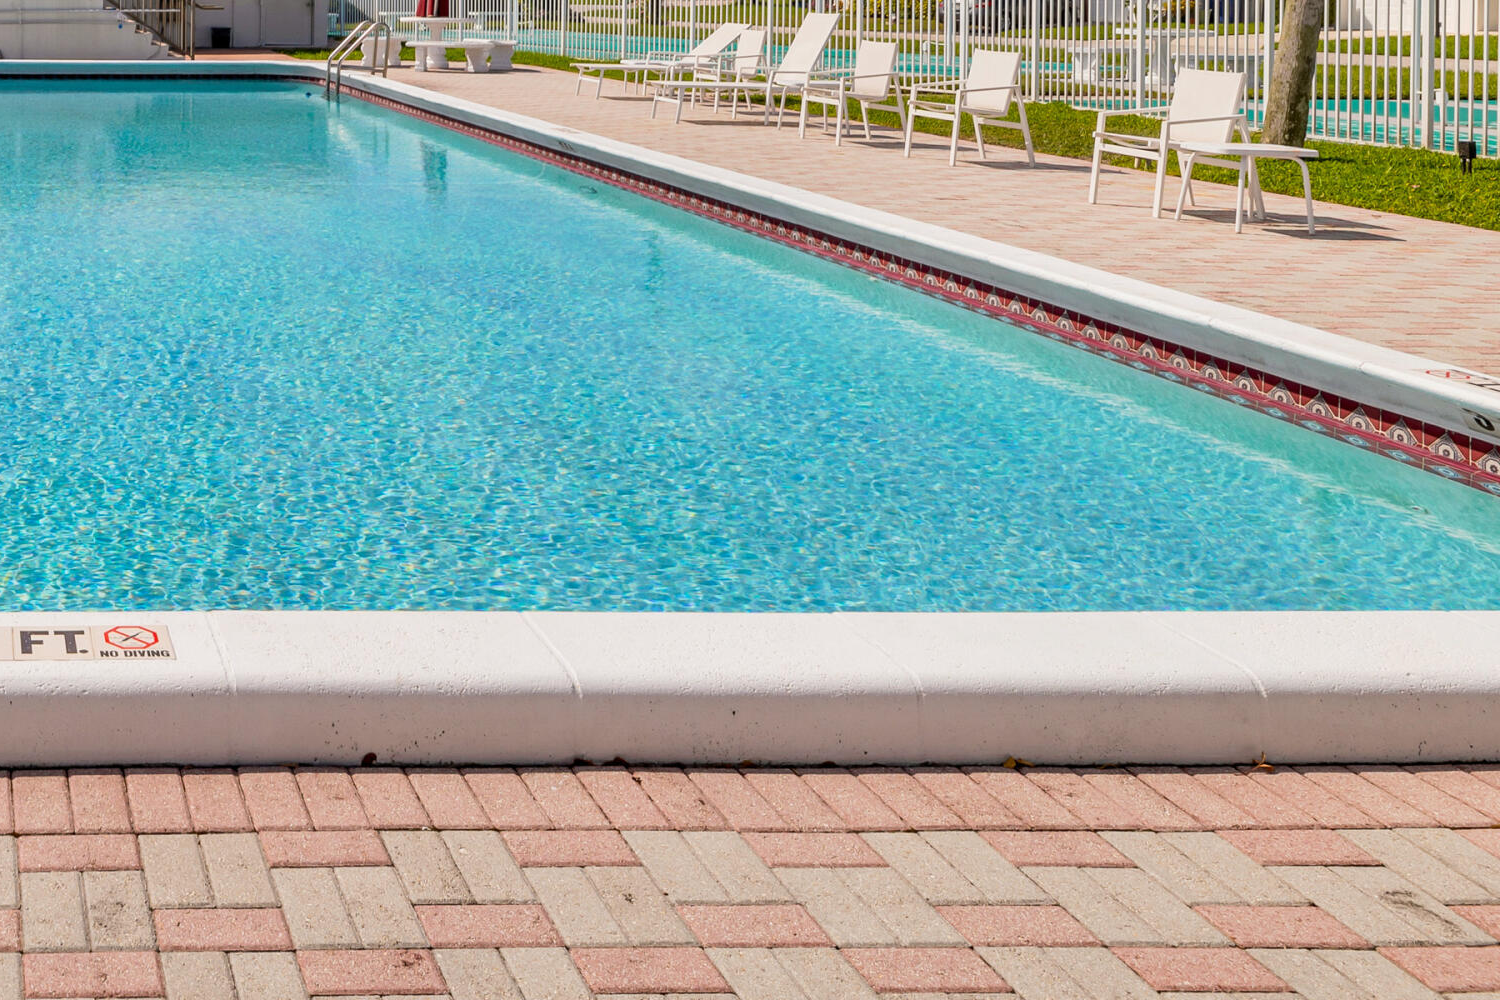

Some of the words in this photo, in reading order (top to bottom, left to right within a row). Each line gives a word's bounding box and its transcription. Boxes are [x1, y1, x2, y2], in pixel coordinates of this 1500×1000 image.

[19, 630, 89, 654] FT.
[100, 649, 119, 658] NO
[124, 649, 171, 658] DIVING
